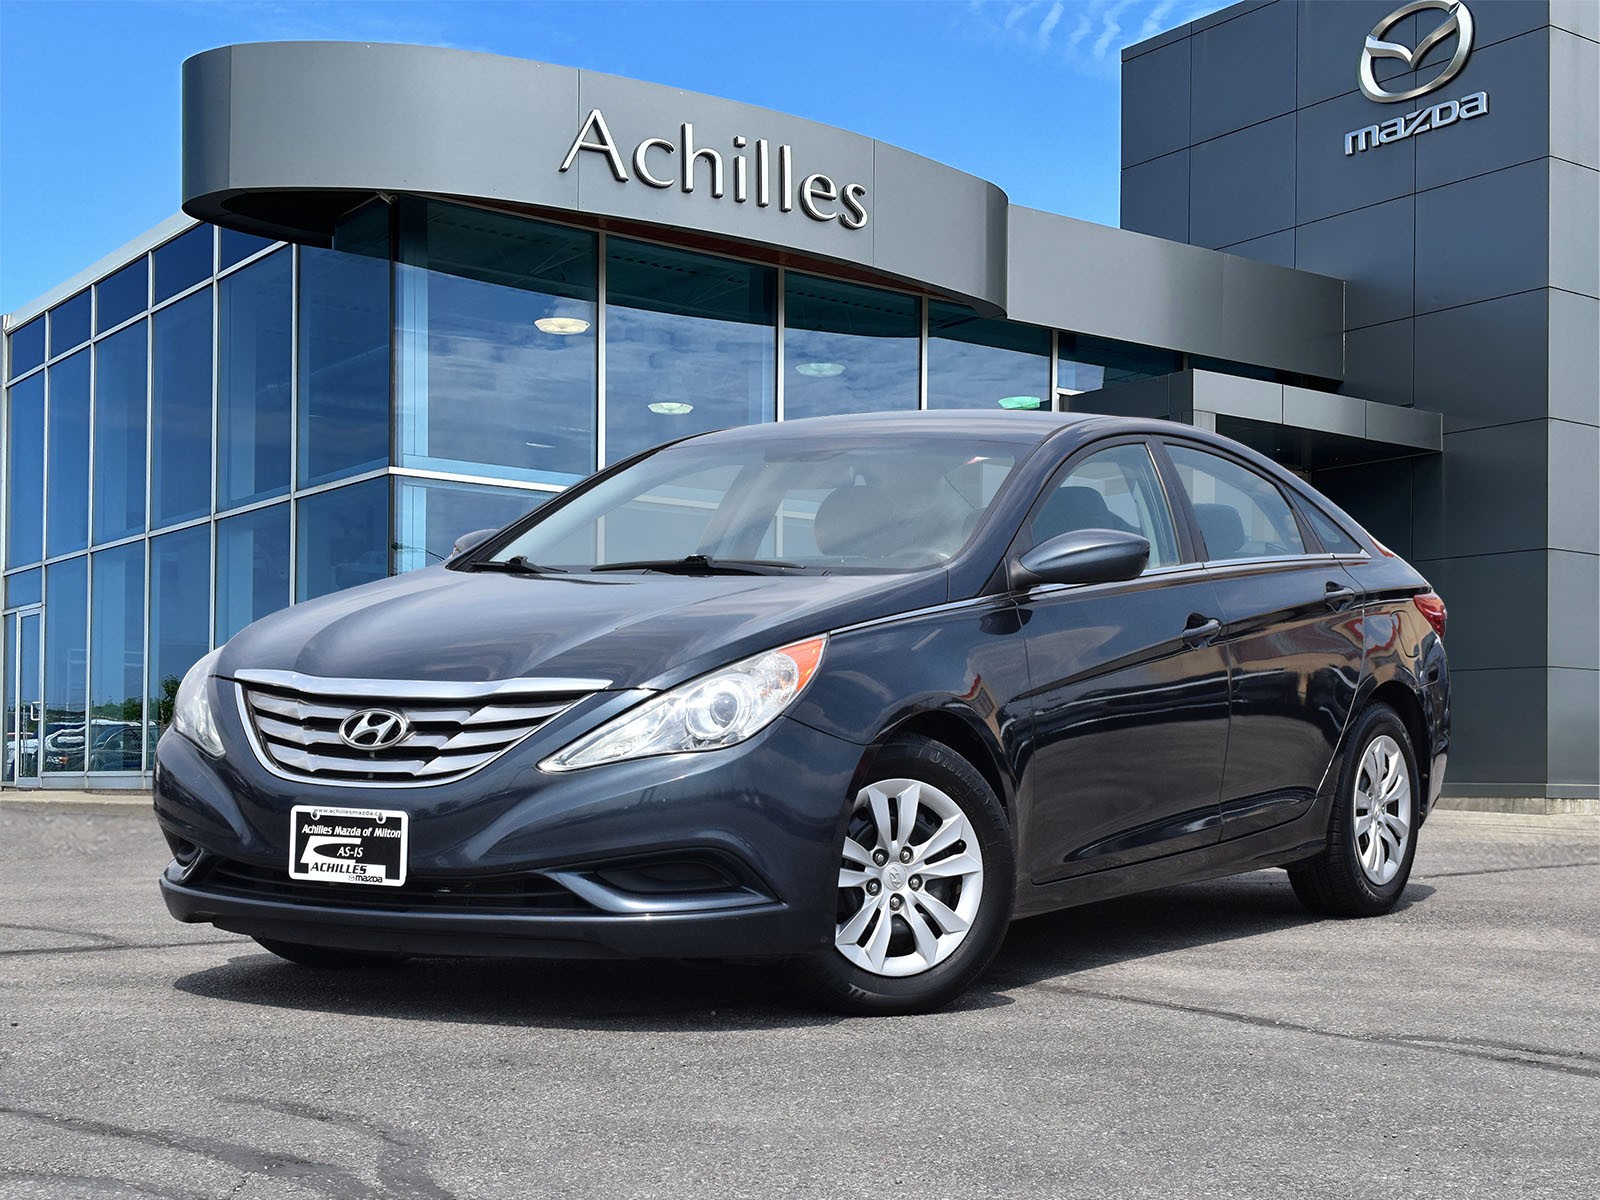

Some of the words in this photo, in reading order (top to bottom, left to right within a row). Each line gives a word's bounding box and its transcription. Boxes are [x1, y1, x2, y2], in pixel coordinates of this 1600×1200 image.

[558, 107, 869, 231] Achilles
[301, 824, 333, 835] Achilles
[334, 826, 362, 837] Mazda
[362, 827, 373, 837] of
[374, 828, 401, 839] Milton
[337, 846, 364, 858] AS-IS
[310, 862, 368, 875] ACHILLES
